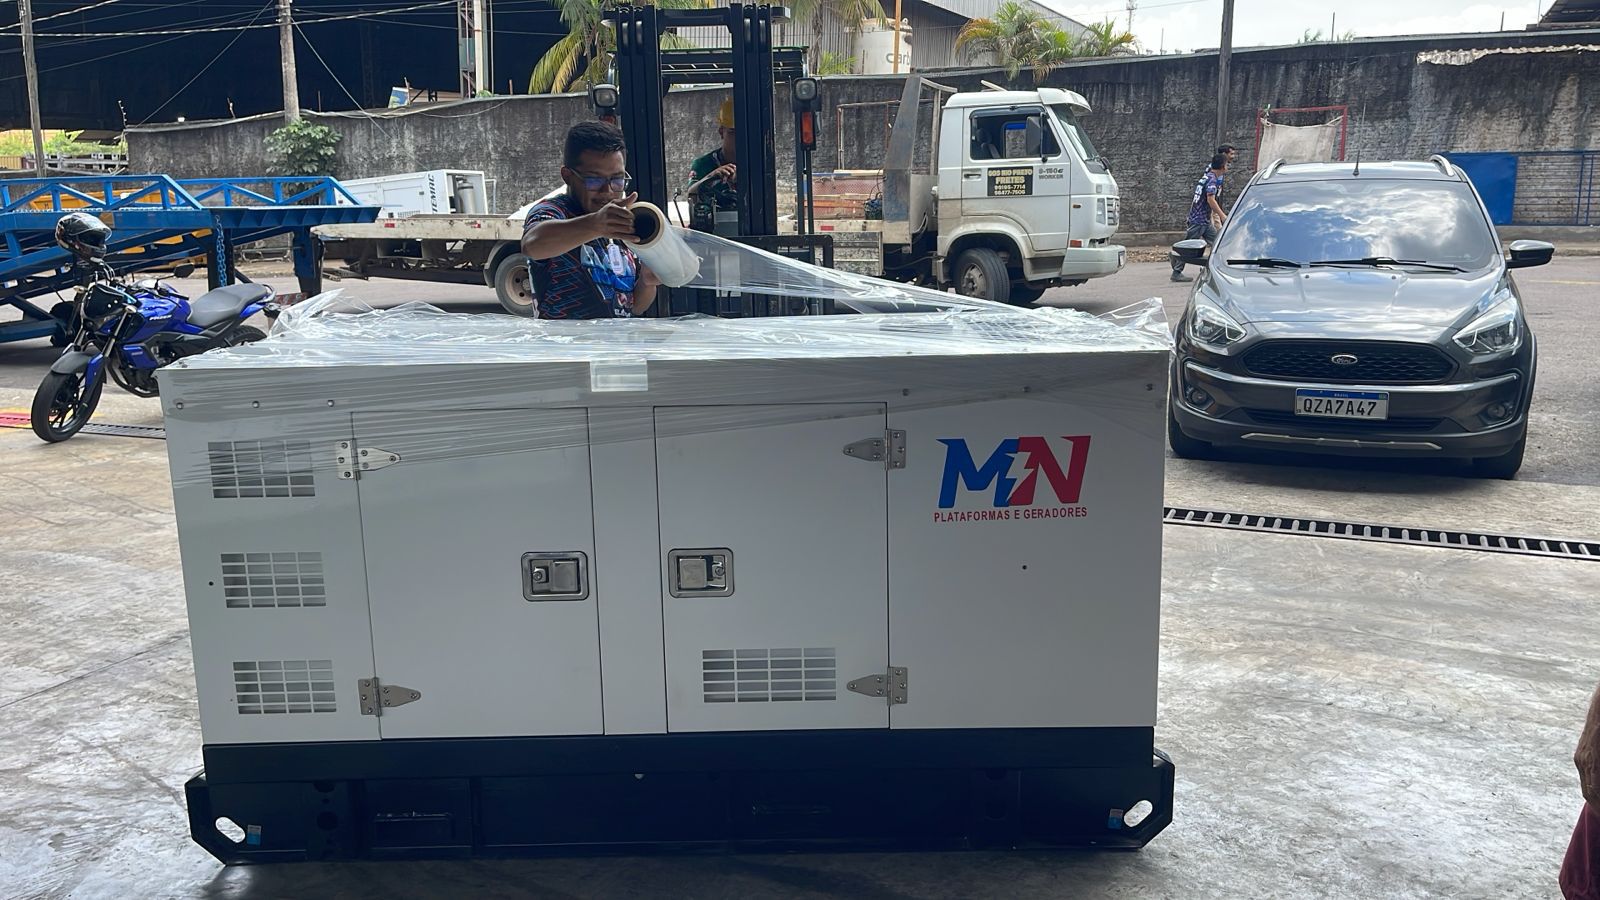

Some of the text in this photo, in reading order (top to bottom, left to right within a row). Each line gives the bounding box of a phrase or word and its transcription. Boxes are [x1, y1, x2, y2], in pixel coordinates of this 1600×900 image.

[995, 176, 1025, 184] FRETES
[1303, 398, 1377, 416] QZA7A47
[934, 506, 1088, 523] PLATAFORMAS E GERADORES
